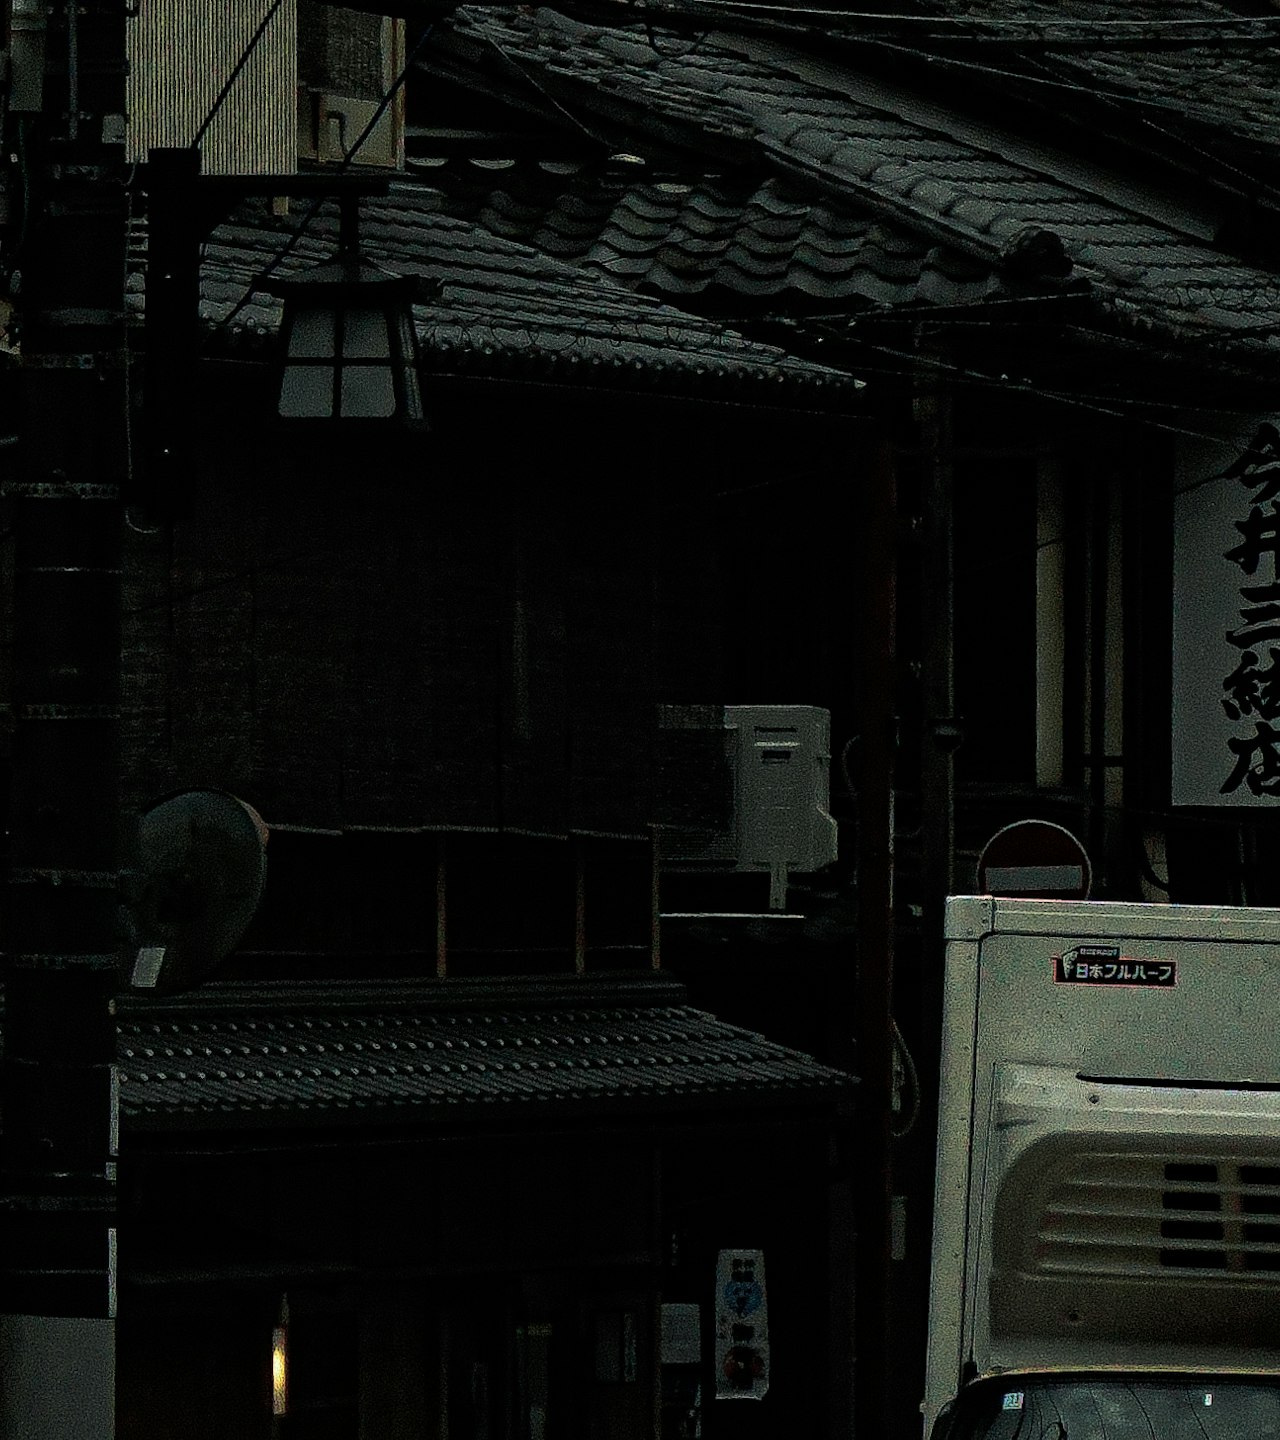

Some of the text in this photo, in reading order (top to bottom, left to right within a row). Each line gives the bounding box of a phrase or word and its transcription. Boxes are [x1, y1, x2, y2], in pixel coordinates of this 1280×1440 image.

[1076, 963, 1172, 980] 日本フルハーフ
